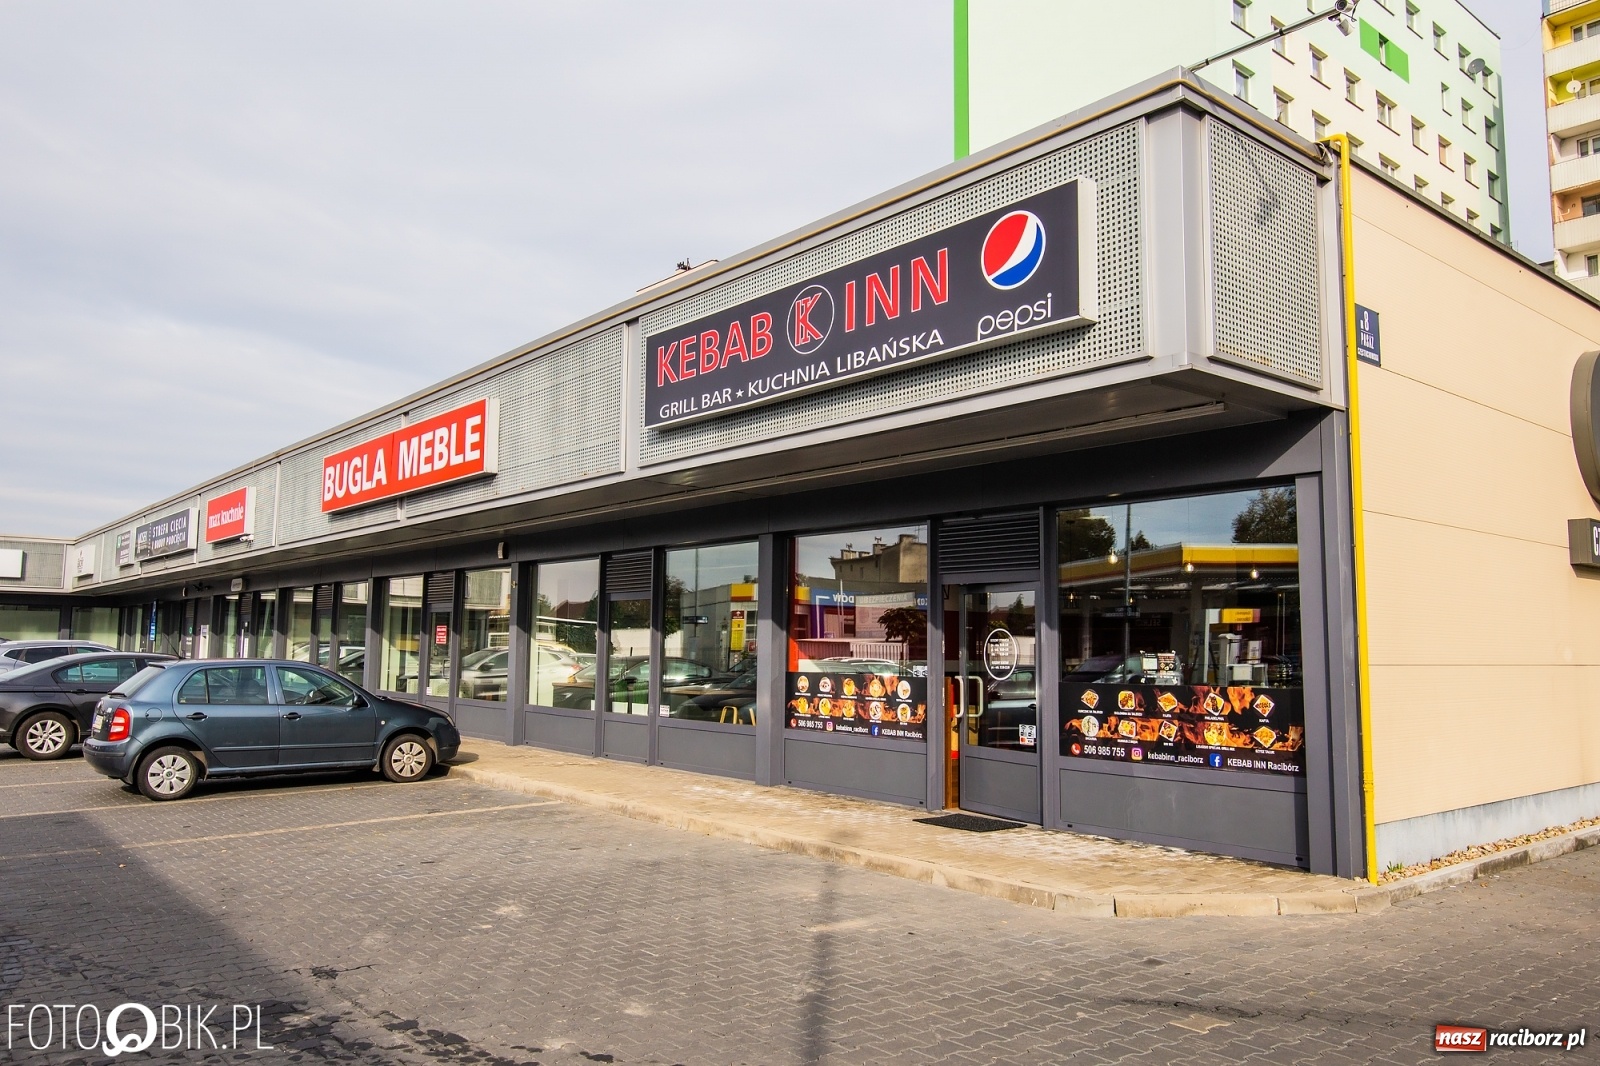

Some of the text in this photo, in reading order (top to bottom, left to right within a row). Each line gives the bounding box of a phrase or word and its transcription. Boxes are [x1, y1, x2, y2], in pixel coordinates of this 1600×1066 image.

[657, 311, 774, 387] KEBAB
[844, 247, 950, 334] INN
[977, 292, 1053, 341] pepsi
[659, 329, 945, 419] GRILL BAR KUCHNIA LIBAŃSKA
[324, 414, 482, 502] BUGLA MEBLE
[208, 513, 221, 529] max
[152, 523, 169, 538] STREFA
[1084, 745, 1125, 757] 506 985 755
[1148, 752, 1203, 764] kebabinn_raciborz
[1227, 758, 1299, 772] KEBAB INN Racibórz
